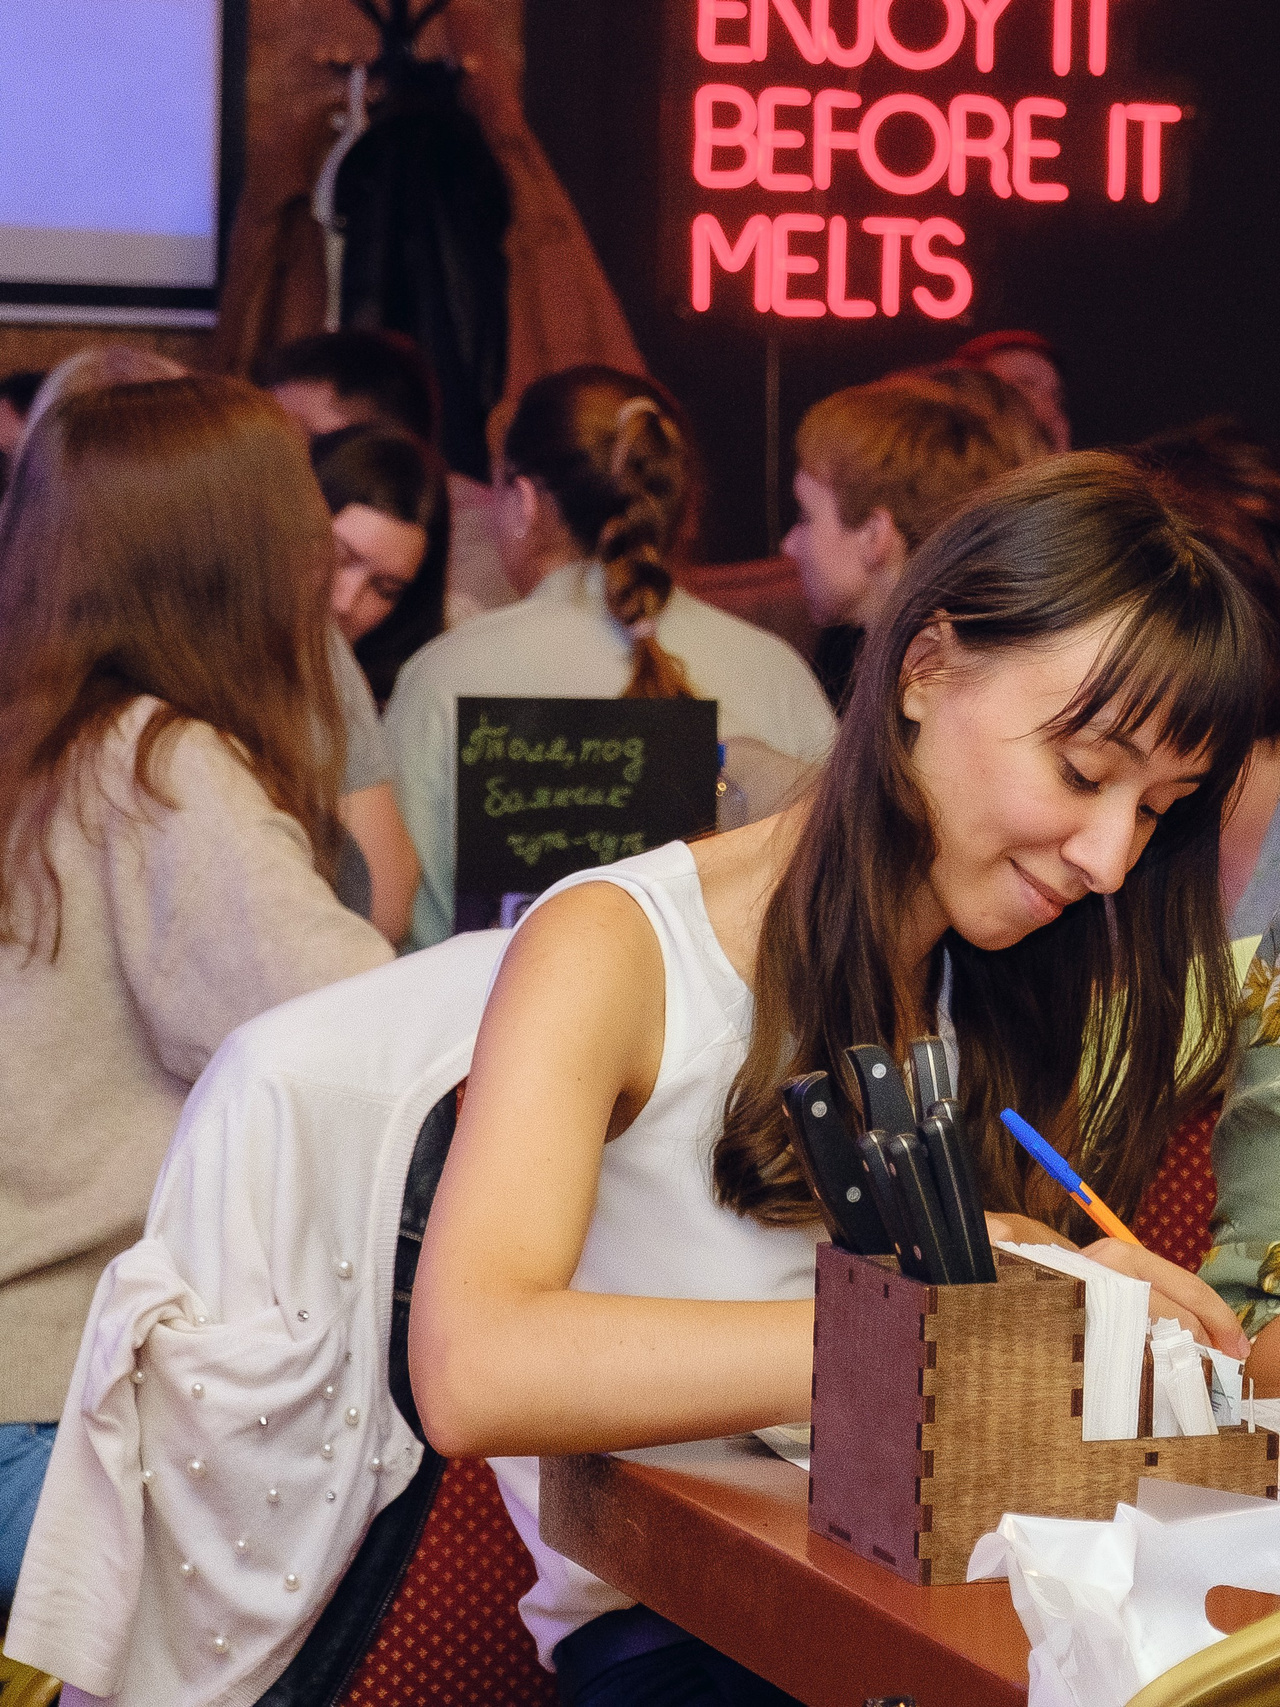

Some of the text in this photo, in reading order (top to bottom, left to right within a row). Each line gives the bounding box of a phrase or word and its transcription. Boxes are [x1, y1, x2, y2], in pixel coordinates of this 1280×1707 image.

[697, 0, 1111, 76] ENJOY IT
[691, 84, 1183, 203] BEFORE IT
[691, 213, 973, 319] MELTS
[579, 737, 645, 782] под
